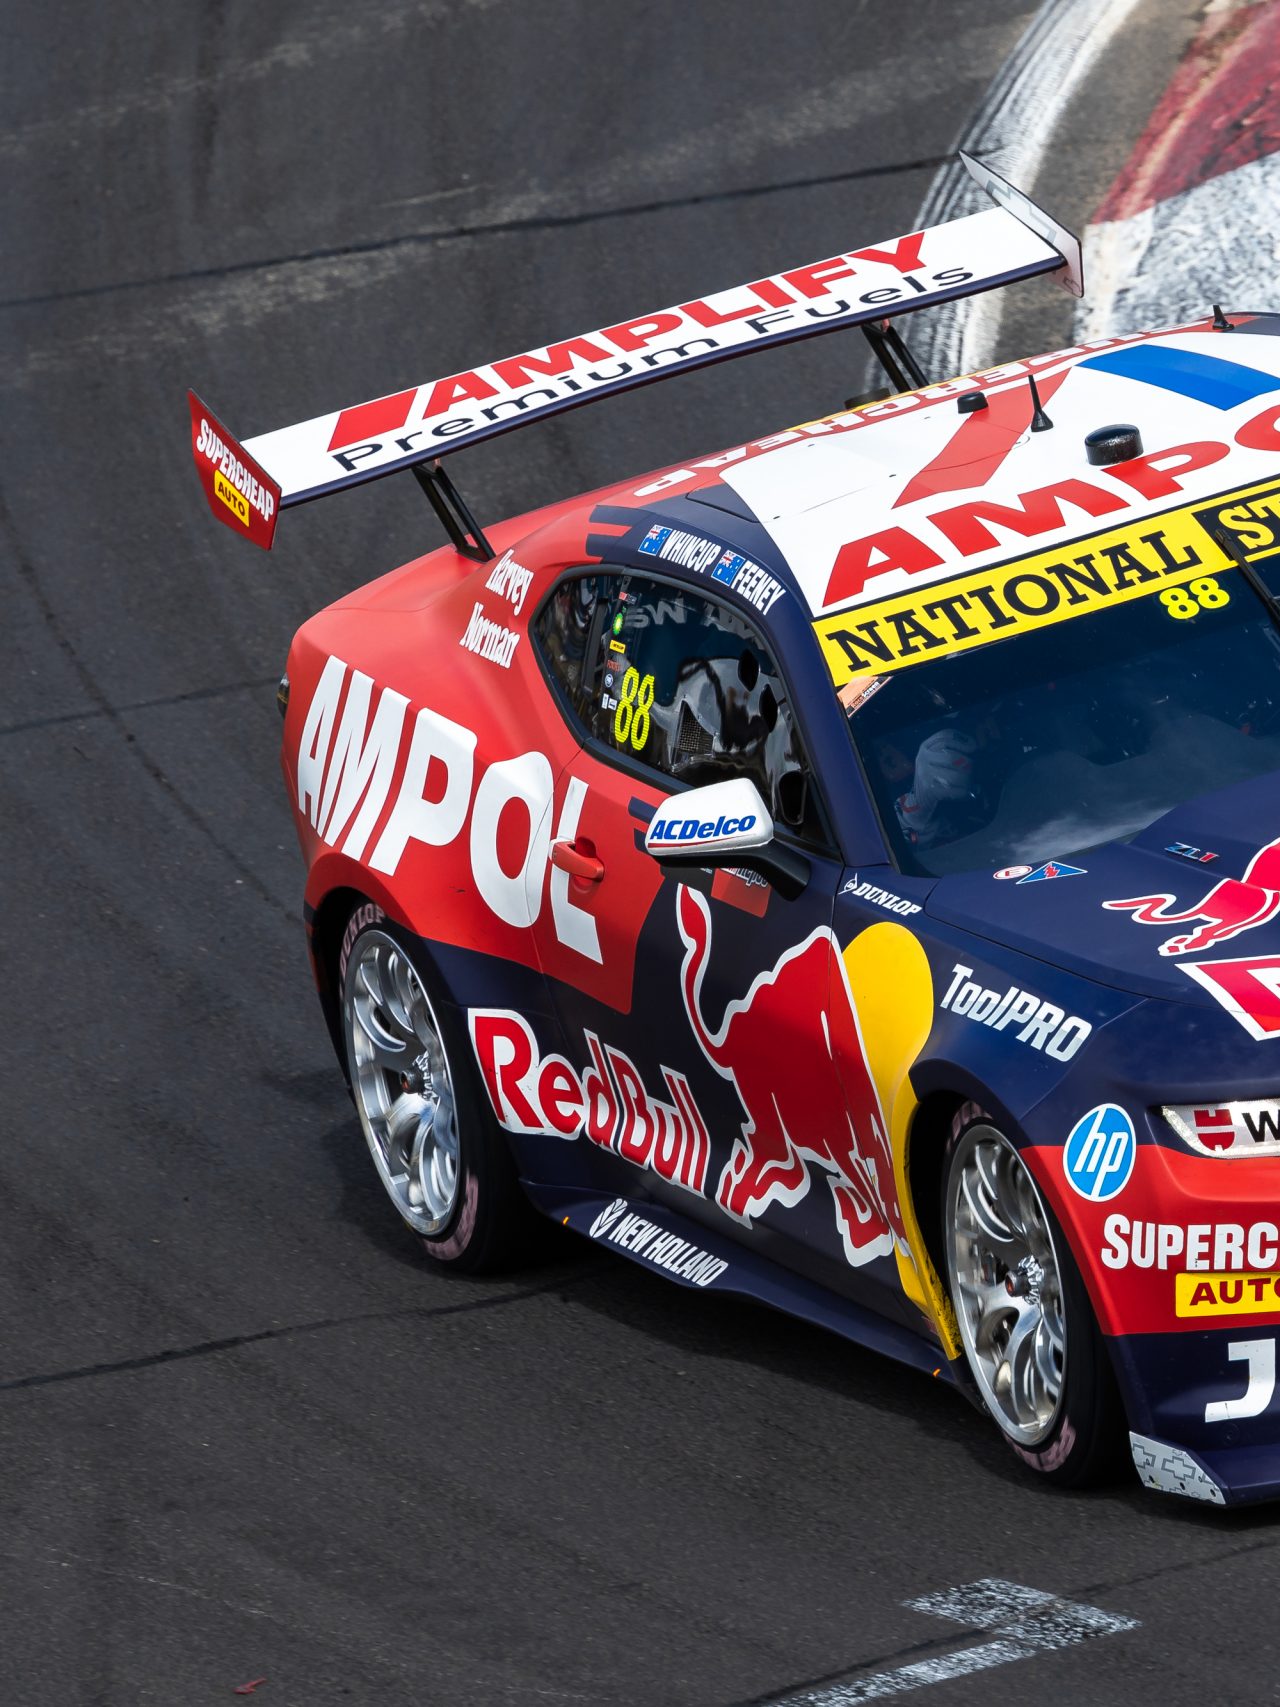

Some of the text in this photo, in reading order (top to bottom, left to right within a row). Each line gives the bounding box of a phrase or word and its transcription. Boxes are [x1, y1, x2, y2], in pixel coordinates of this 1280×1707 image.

[423, 231, 926, 419] AMPLIFY
[331, 266, 974, 471] Premium Fuels
[196, 418, 275, 522] SUPERCHEAP
[218, 481, 246, 517] AUTO
[485, 549, 535, 616] Harvey
[659, 528, 722, 574] WHINCUP
[731, 560, 787, 616] FEENEY
[827, 529, 1202, 672] NATIONAL
[1159, 578, 1230, 620] 88
[460, 602, 520, 669] Norman
[614, 666, 655, 751] 88
[297, 654, 604, 965] AMPOL
[649, 813, 757, 841] ACDelco
[852, 881, 922, 917] DUNLOP
[940, 963, 1093, 1063] ToolPRO
[1073, 1104, 1130, 1199] hp
[608, 1213, 729, 1287] NEW HOLLAND
